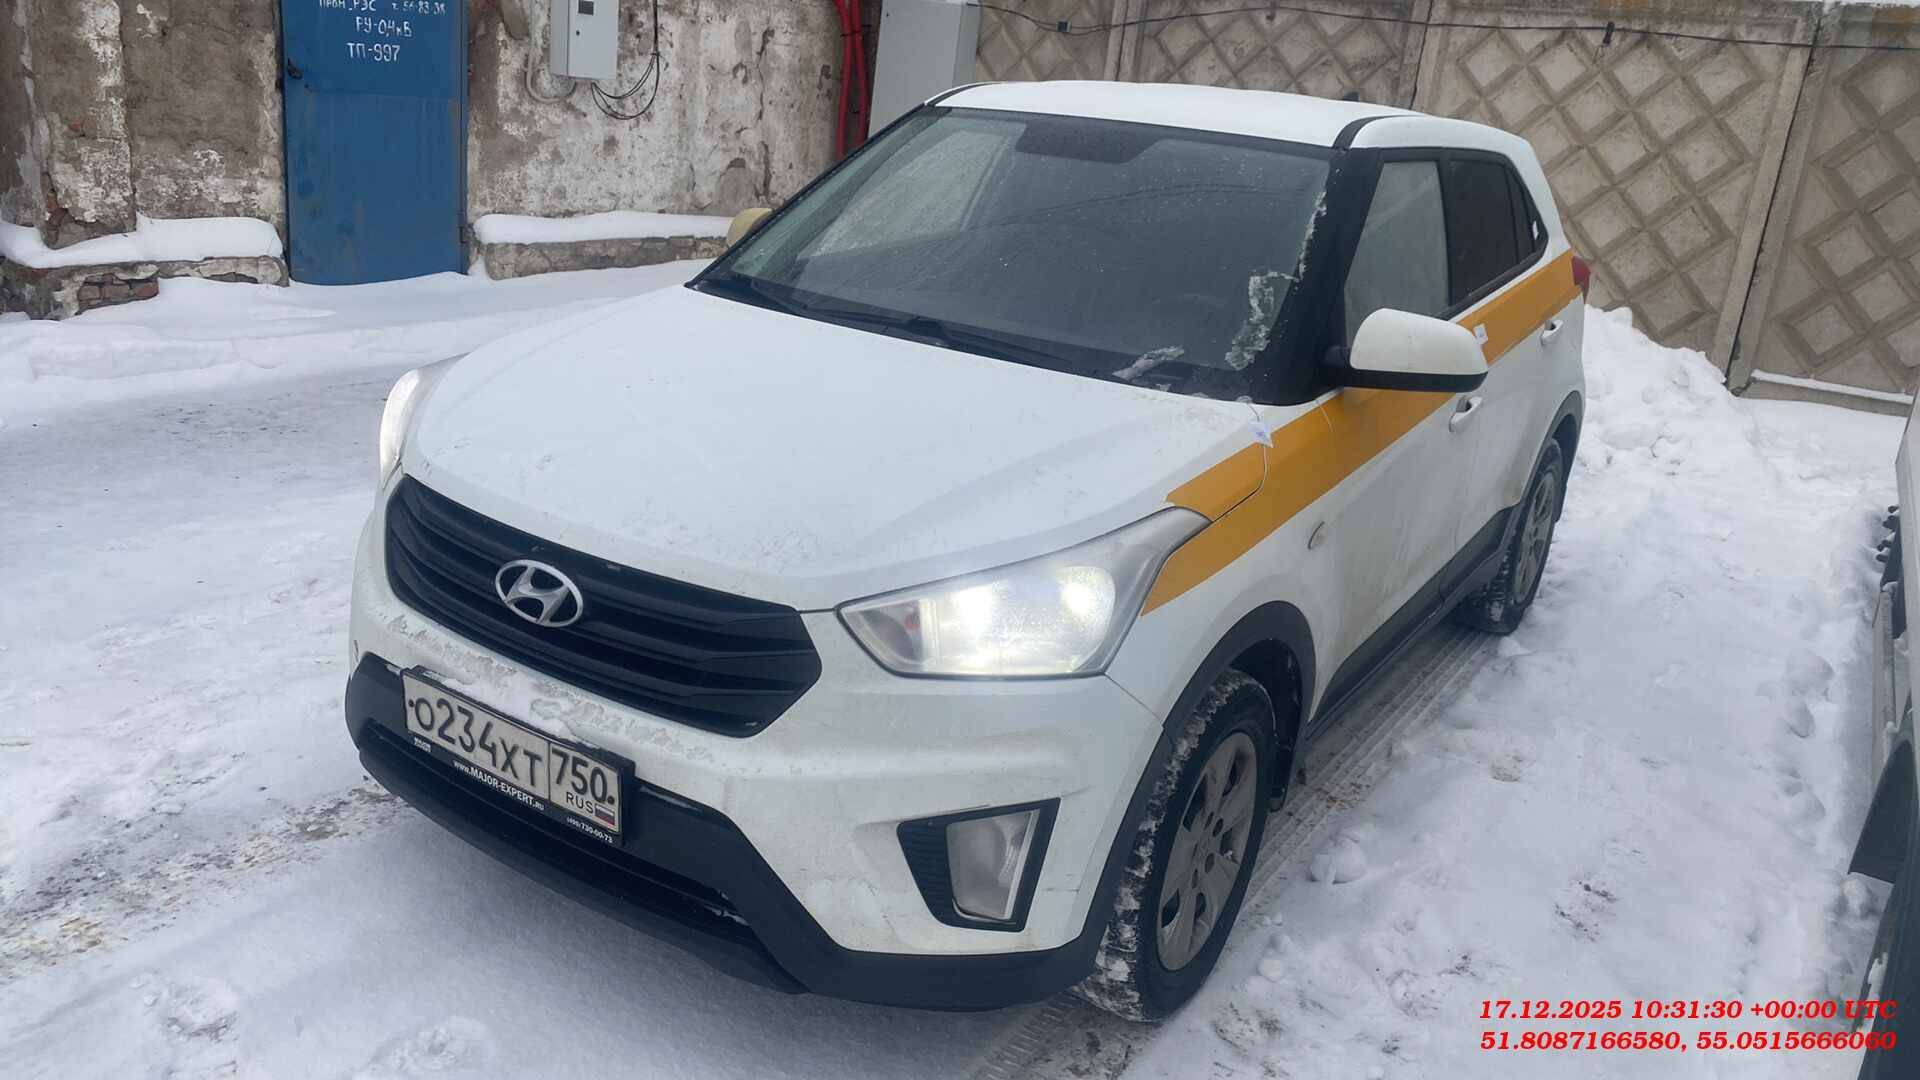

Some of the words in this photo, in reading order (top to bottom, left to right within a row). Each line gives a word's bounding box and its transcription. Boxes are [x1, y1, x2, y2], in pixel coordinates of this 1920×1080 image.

[347, 42, 401, 62] ТП-997
[551, 746, 608, 804] 750
[566, 790, 594, 814] RUS
